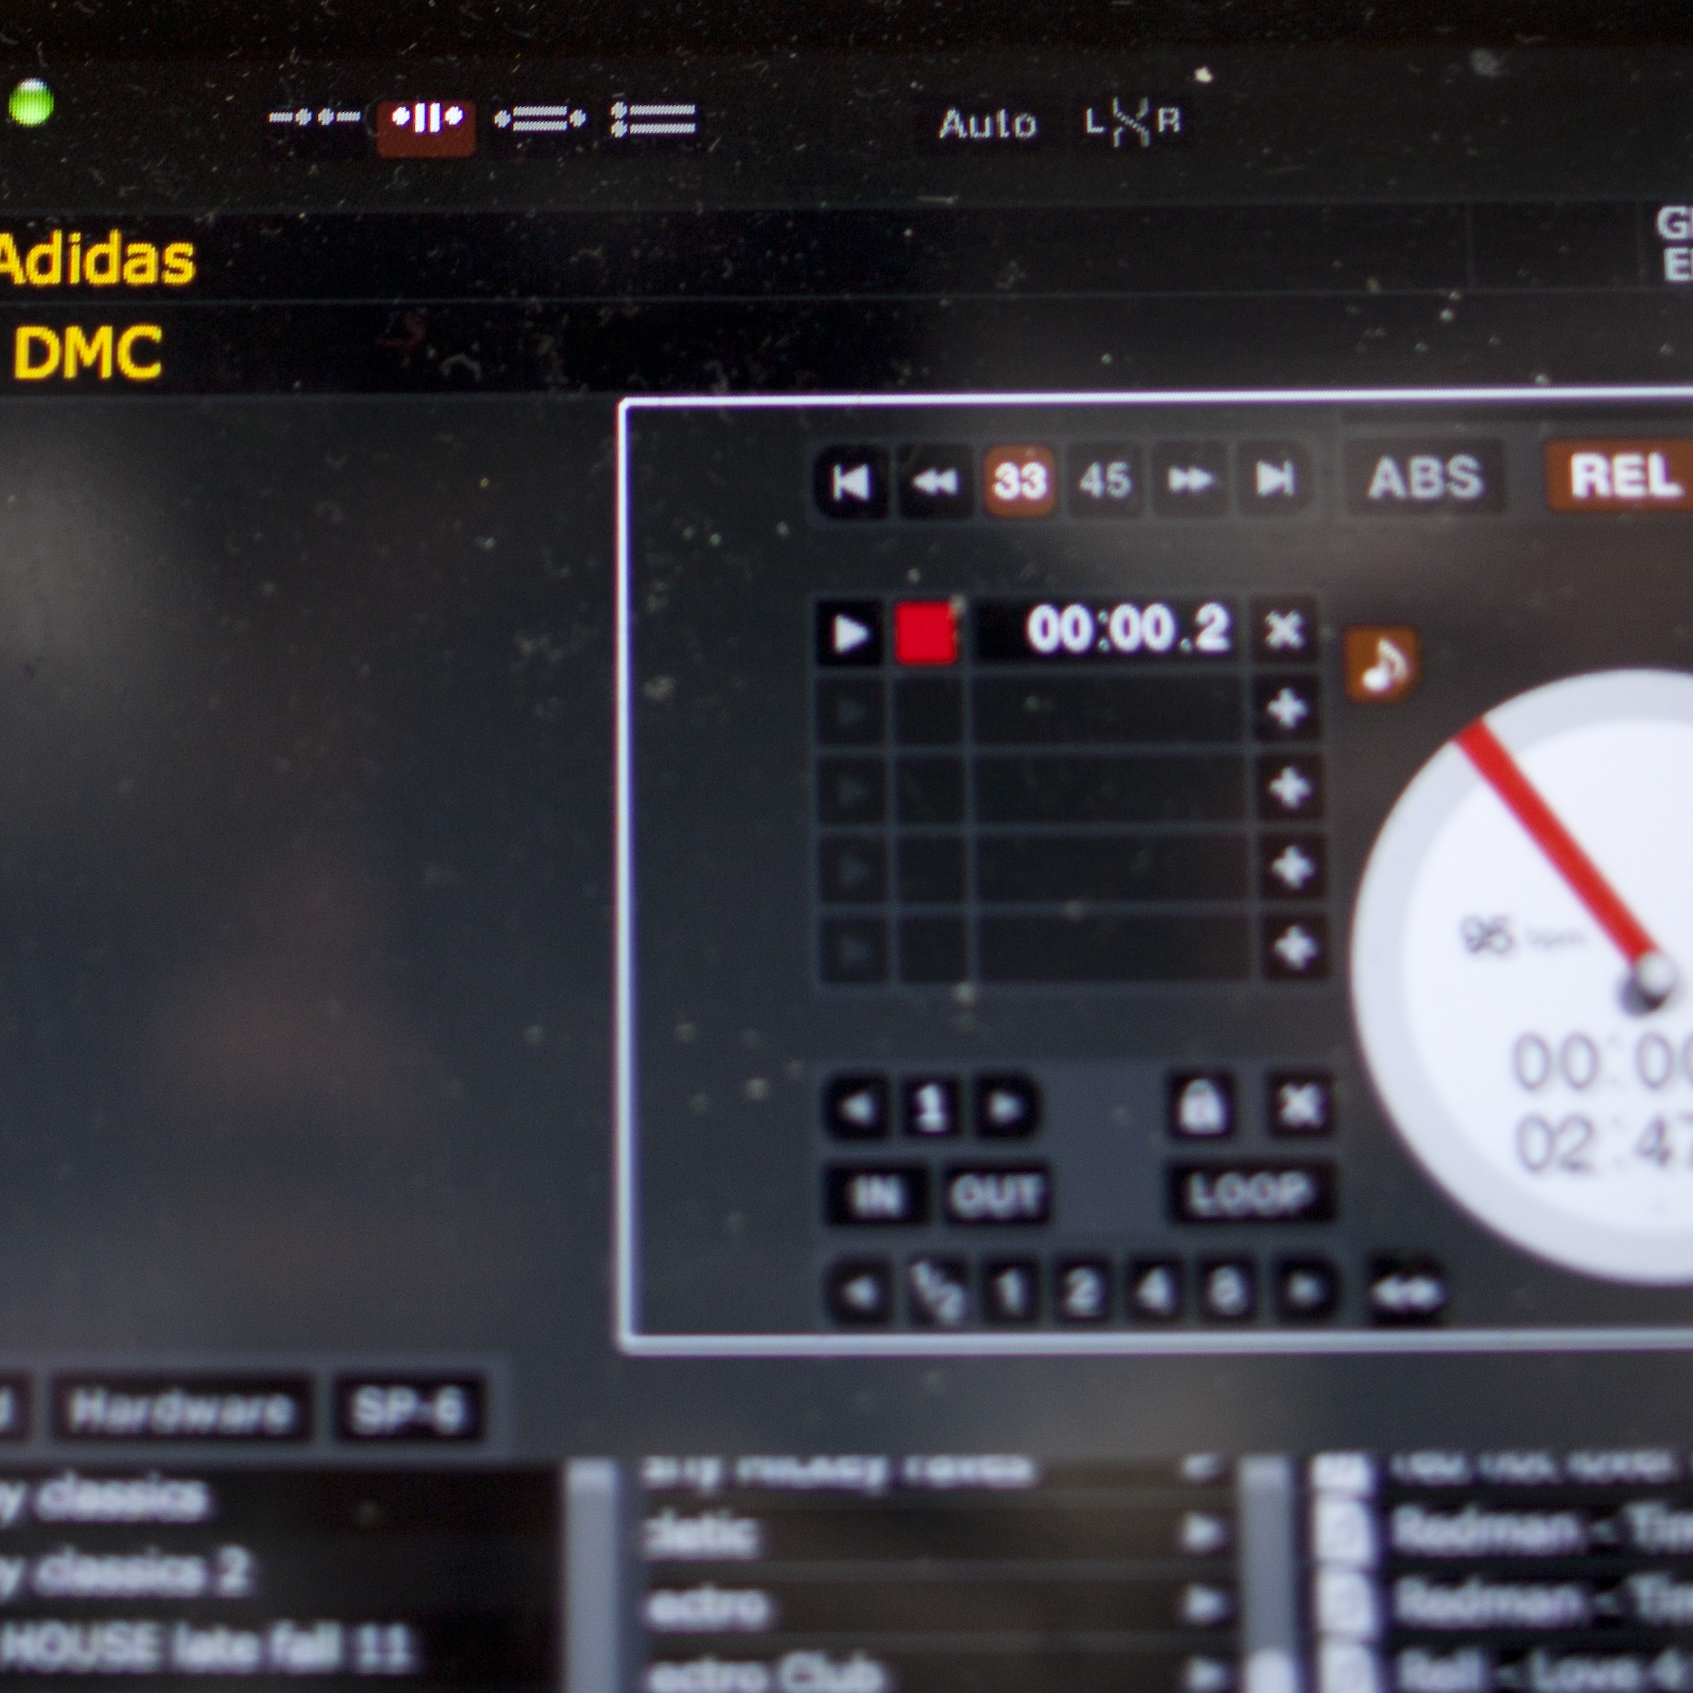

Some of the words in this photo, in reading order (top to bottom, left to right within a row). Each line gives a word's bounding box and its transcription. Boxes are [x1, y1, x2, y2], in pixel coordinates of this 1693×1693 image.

[939, 108, 1038, 139] Auto
[15, 324, 163, 380] DMC
[993, 461, 1048, 500] 33
[1079, 461, 1131, 499] 45
[1367, 455, 1485, 500] ABS
[1569, 451, 1683, 499] REL
[1026, 602, 1230, 654] 00:00.2
[1460, 915, 1514, 955] 95
[914, 1083, 948, 1135] 1
[851, 1174, 901, 1216] IN
[950, 1173, 1043, 1215] OUT
[1189, 1171, 1312, 1217] LOOP
[1064, 1266, 1102, 1317] 2
[1138, 1265, 1174, 1315] 4
[70, 1385, 293, 1436] Hardware
[351, 1385, 464, 1435] SP-6
[36, 1468, 210, 1523] classics
[1393, 1502, 1584, 1557] Redman
[35, 1545, 207, 1599] classics
[216, 1546, 254, 1599] 2
[1394, 1574, 1586, 1629] Redman
[1530, 1646, 1643, 1693] Love
